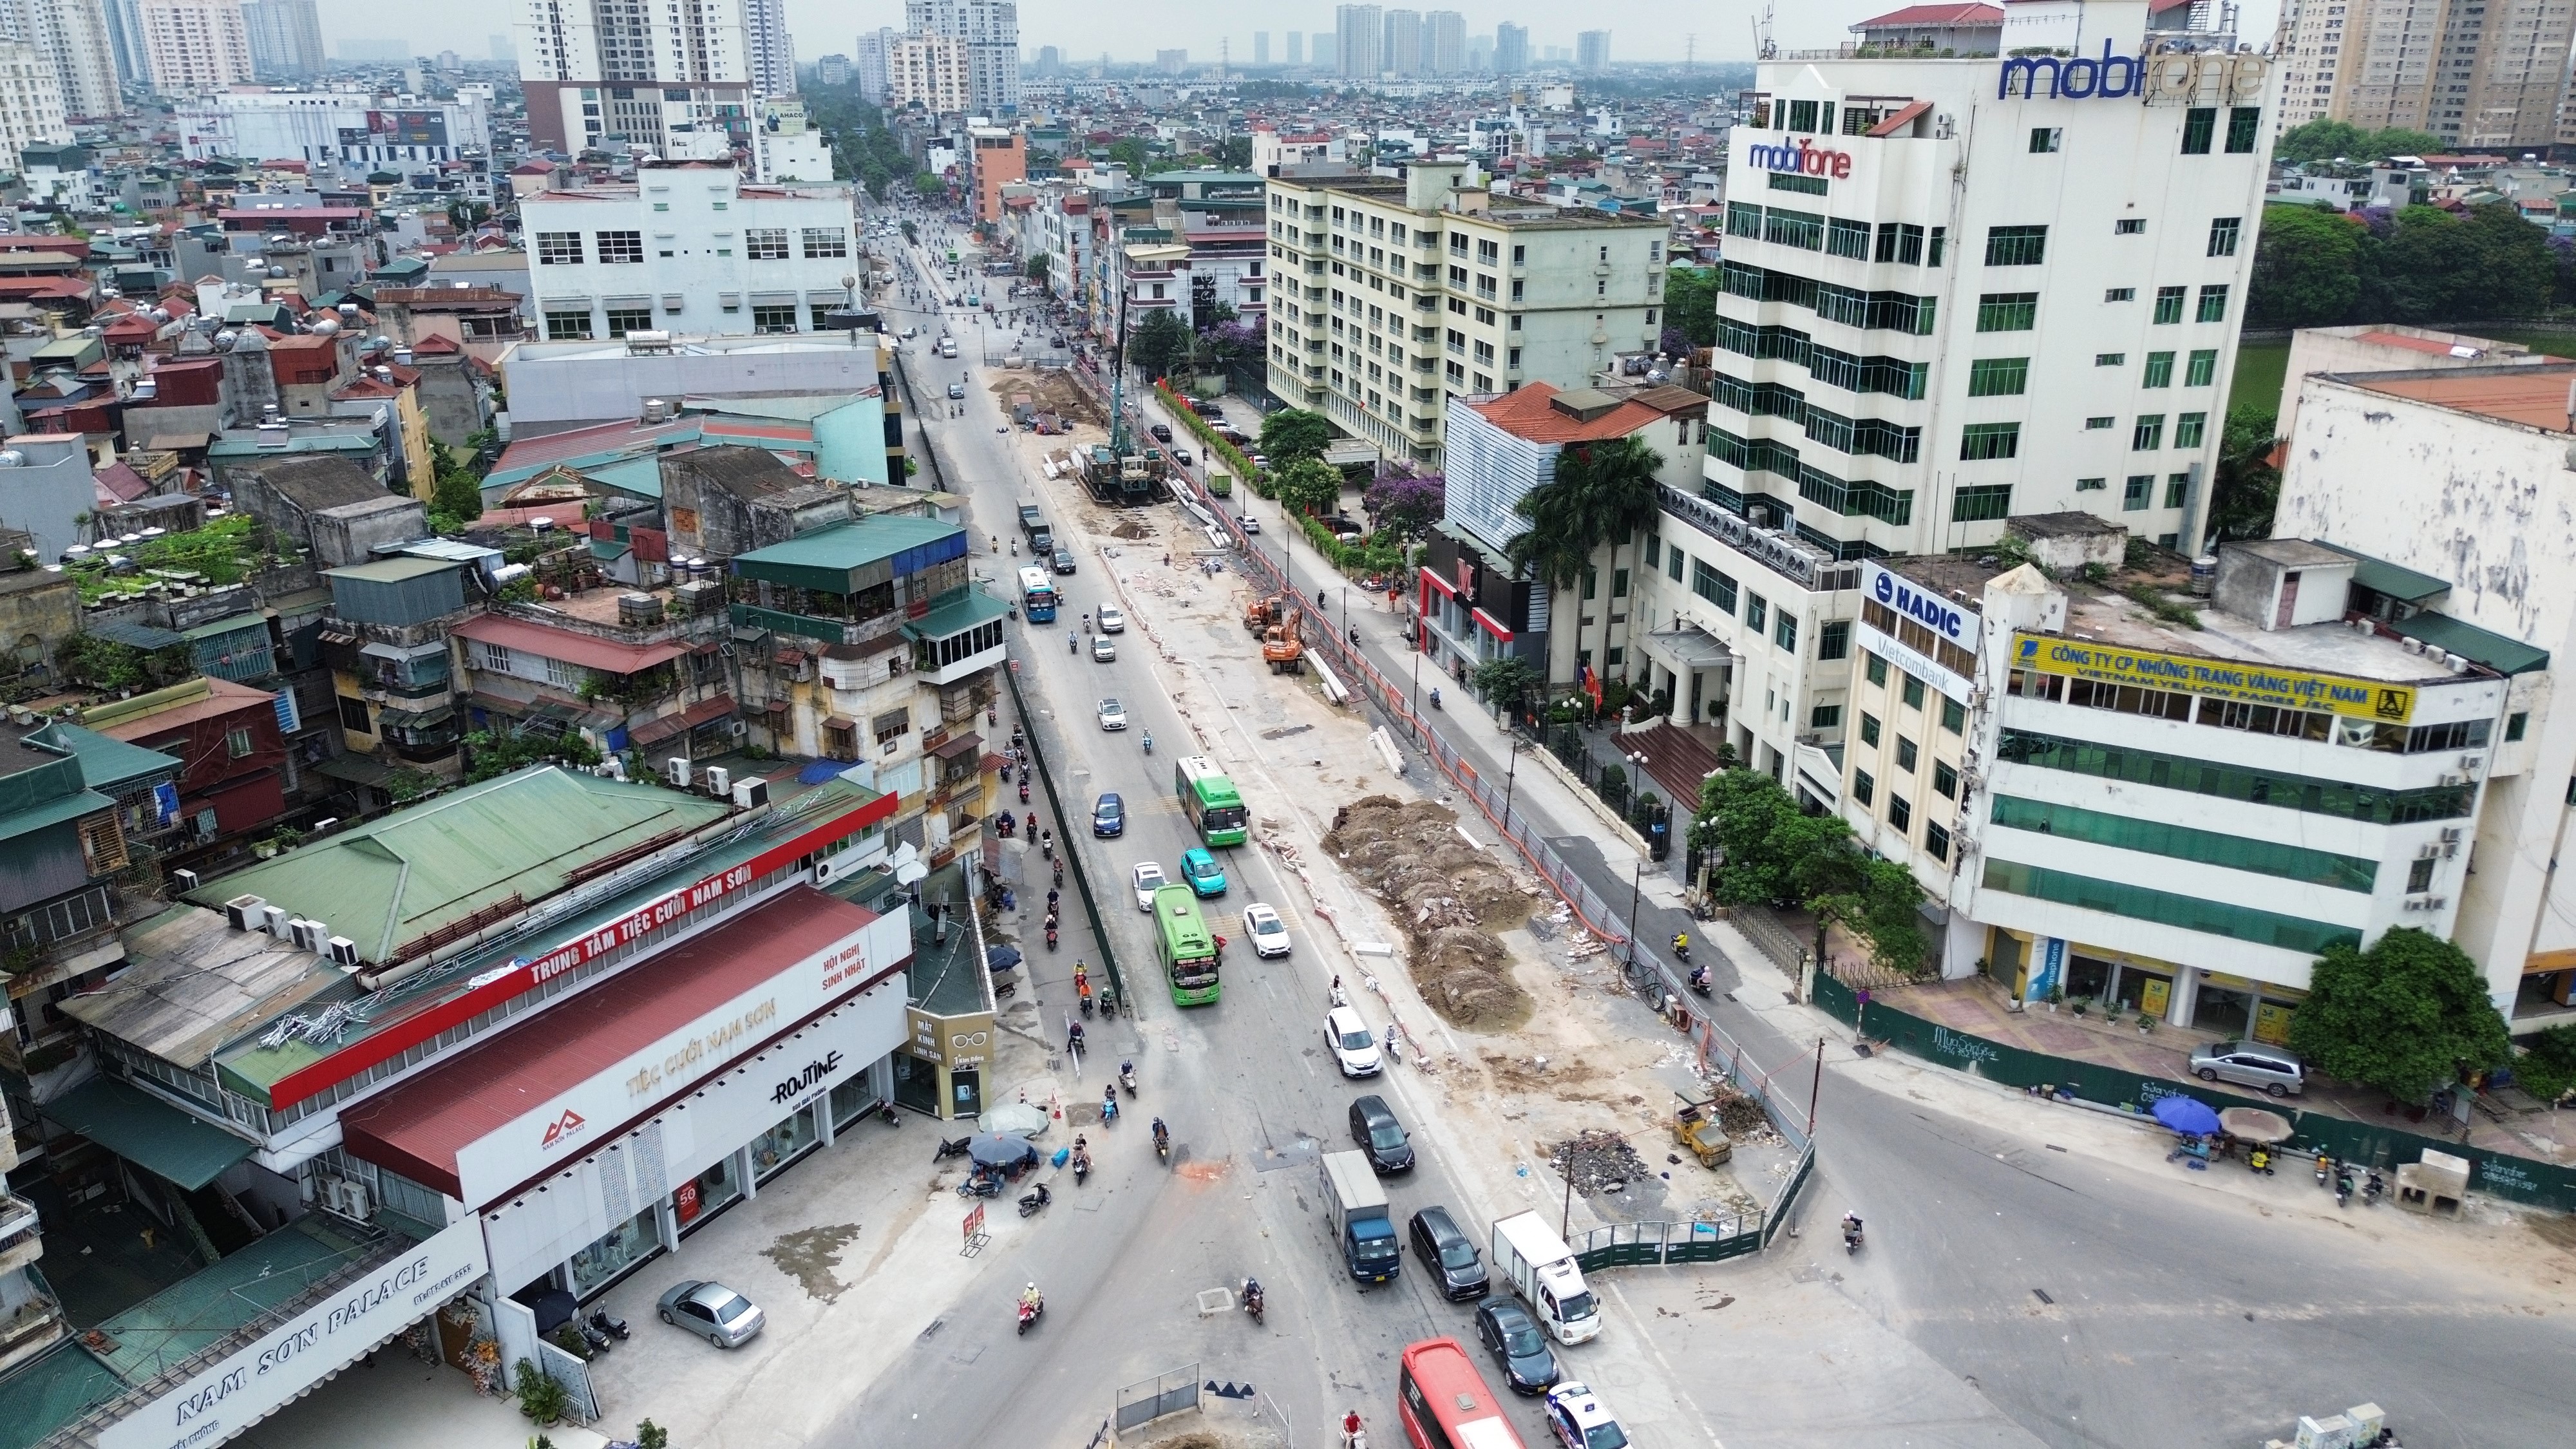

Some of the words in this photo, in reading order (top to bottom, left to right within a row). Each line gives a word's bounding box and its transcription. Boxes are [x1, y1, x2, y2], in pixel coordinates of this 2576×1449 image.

[1998, 37, 2266, 100] mobifone
[1749, 136, 1851, 180] mobifone
[1896, 585, 1961, 637] HADIC
[1878, 636, 1949, 692] Vietcombank
[2051, 644, 2090, 665] CÔNG
[2095, 652, 2112, 668] TY
[2115, 656, 2134, 670] CP
[2136, 656, 2188, 679] NHỮNG
[2193, 666, 2242, 687] TRANG
[2248, 672, 2289, 693] VÀNG
[2293, 679, 2327, 697] VIỆT
[2330, 685, 2368, 704] NAM
[2077, 667, 2155, 685] VIETNAM
[2160, 679, 2233, 696] YELLOW
[531, 947, 580, 984] TRUNG
[585, 932, 616, 958] TÂM
[621, 914, 652, 938] TIỆC
[655, 893, 686, 923] CƯỚI
[692, 884, 723, 906] NAM
[727, 866, 752, 889] SƠN
[822, 974, 842, 991] SINH
[844, 958, 866, 978] NHẬT
[824, 953, 838, 972] HỘI
[840, 943, 860, 963] NGHỊ
[2046, 943, 2060, 989] vinaphone
[665, 1037, 703, 1077] CƯỚI
[706, 1018, 744, 1052] NAM
[745, 998, 777, 1029] SƠN
[917, 1019, 933, 1033] MẮT
[918, 1034, 936, 1047] KÍNH
[913, 1045, 928, 1057] LINH
[770, 1050, 844, 1104] ROUTINE
[542, 1141, 554, 1152] NAM
[566, 1123, 585, 1138] PALACE
[680, 1188, 696, 1205] 50
[455, 1263, 473, 1280] 3333
[176, 1367, 247, 1426] NAM
[258, 1322, 319, 1376] SƠN
[328, 1256, 429, 1335] PALACE
[189, 1420, 220, 1444] PHÓNG
